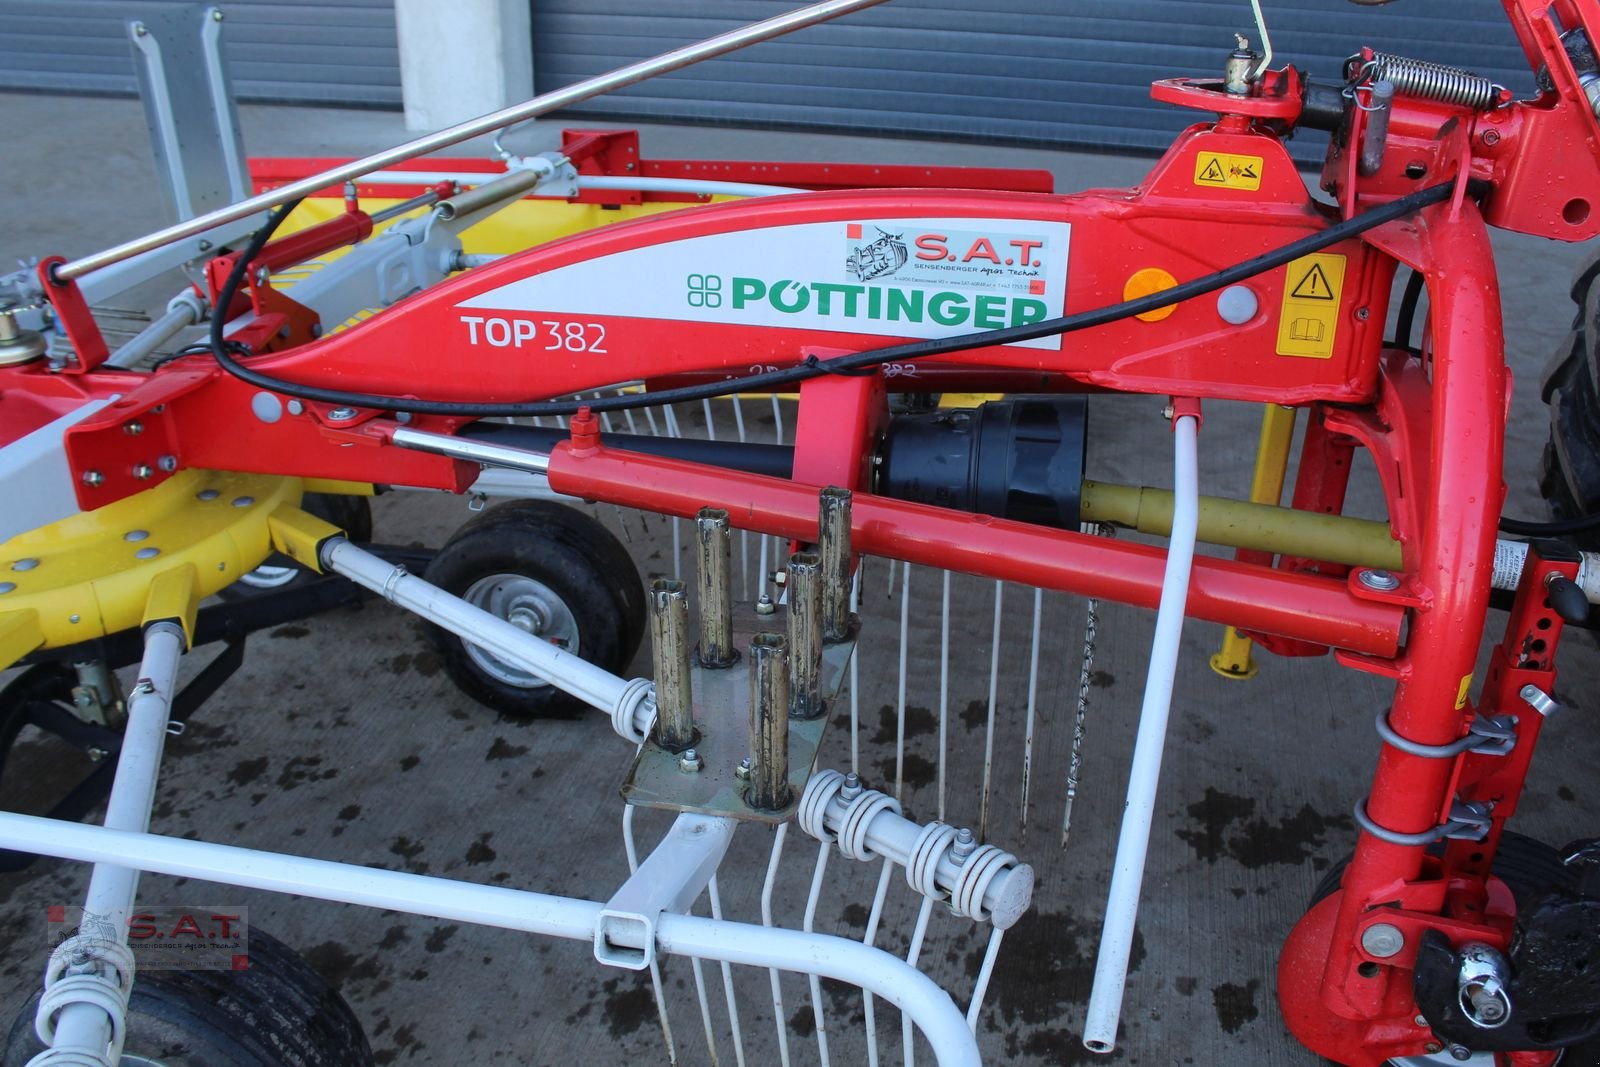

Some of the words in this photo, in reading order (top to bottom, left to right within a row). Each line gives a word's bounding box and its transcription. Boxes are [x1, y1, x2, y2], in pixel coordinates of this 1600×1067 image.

[914, 234, 1042, 267] S.A.T.
[914, 263, 978, 273] SENSENBERGER
[1007, 269, 1040, 277] Technik
[732, 277, 1048, 329] PÖTTINGER
[460, 315, 537, 348] TOP
[542, 320, 608, 354] 382
